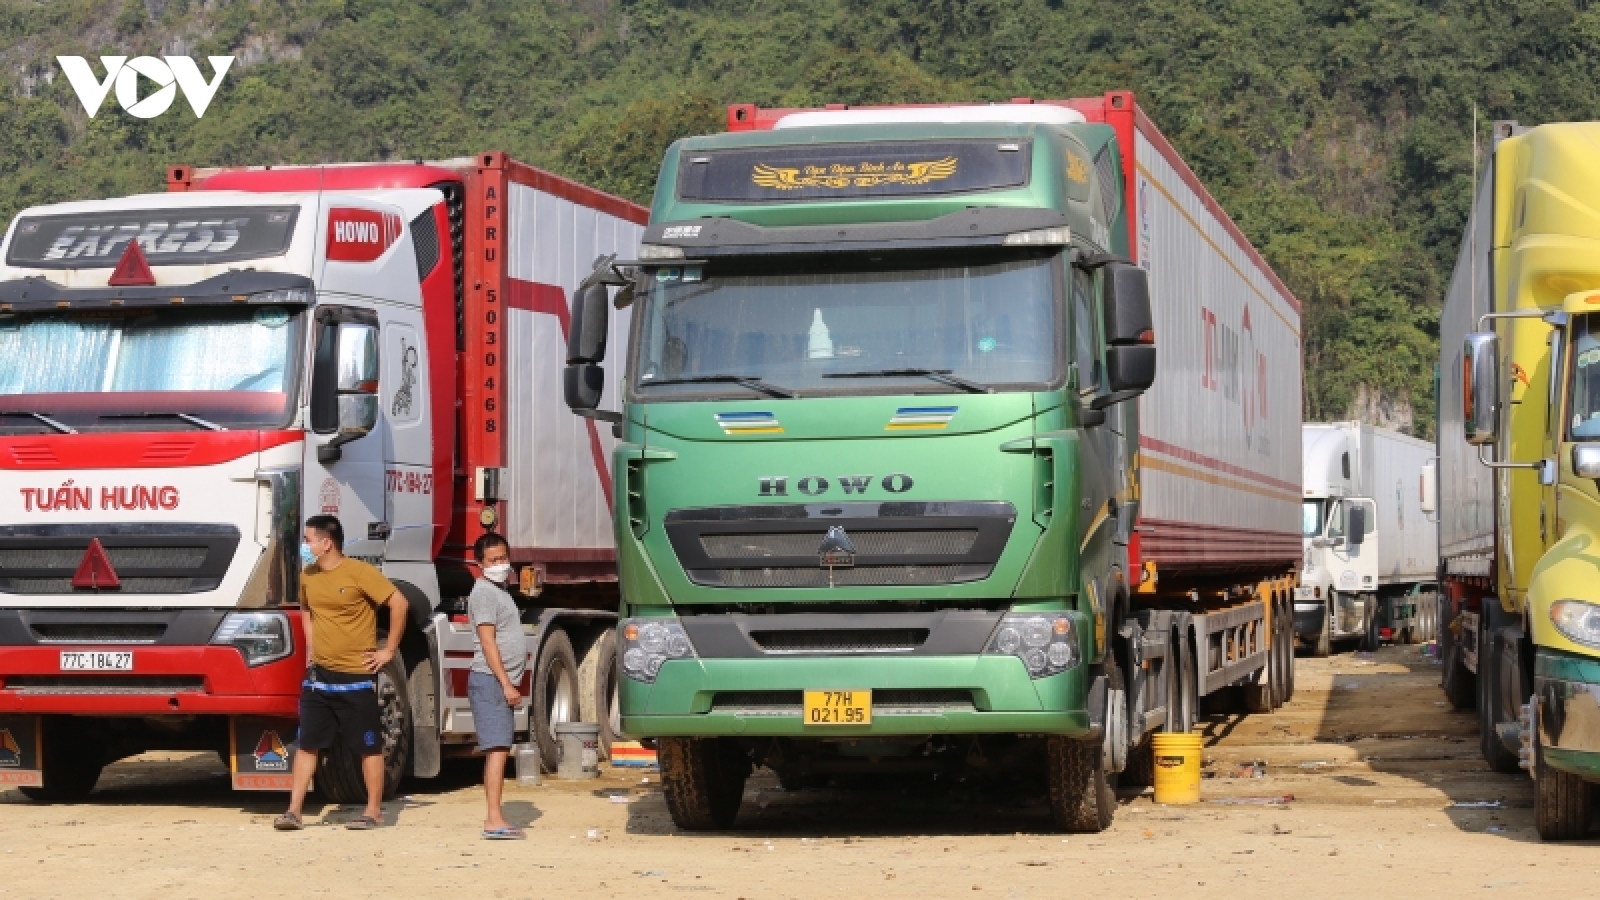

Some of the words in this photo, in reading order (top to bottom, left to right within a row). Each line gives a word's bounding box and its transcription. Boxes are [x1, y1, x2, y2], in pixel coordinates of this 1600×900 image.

[334, 220, 379, 244] HOWO
[485, 186, 498, 262] APRU
[44, 218, 249, 260] EXPRESS
[484, 288, 498, 434] 5030468
[20, 478, 92, 512] TUẤN
[100, 484, 180, 511] HƯNG
[758, 472, 914, 497] HOWO
[823, 691, 853, 707] 77H
[811, 707, 865, 723] 021.95
